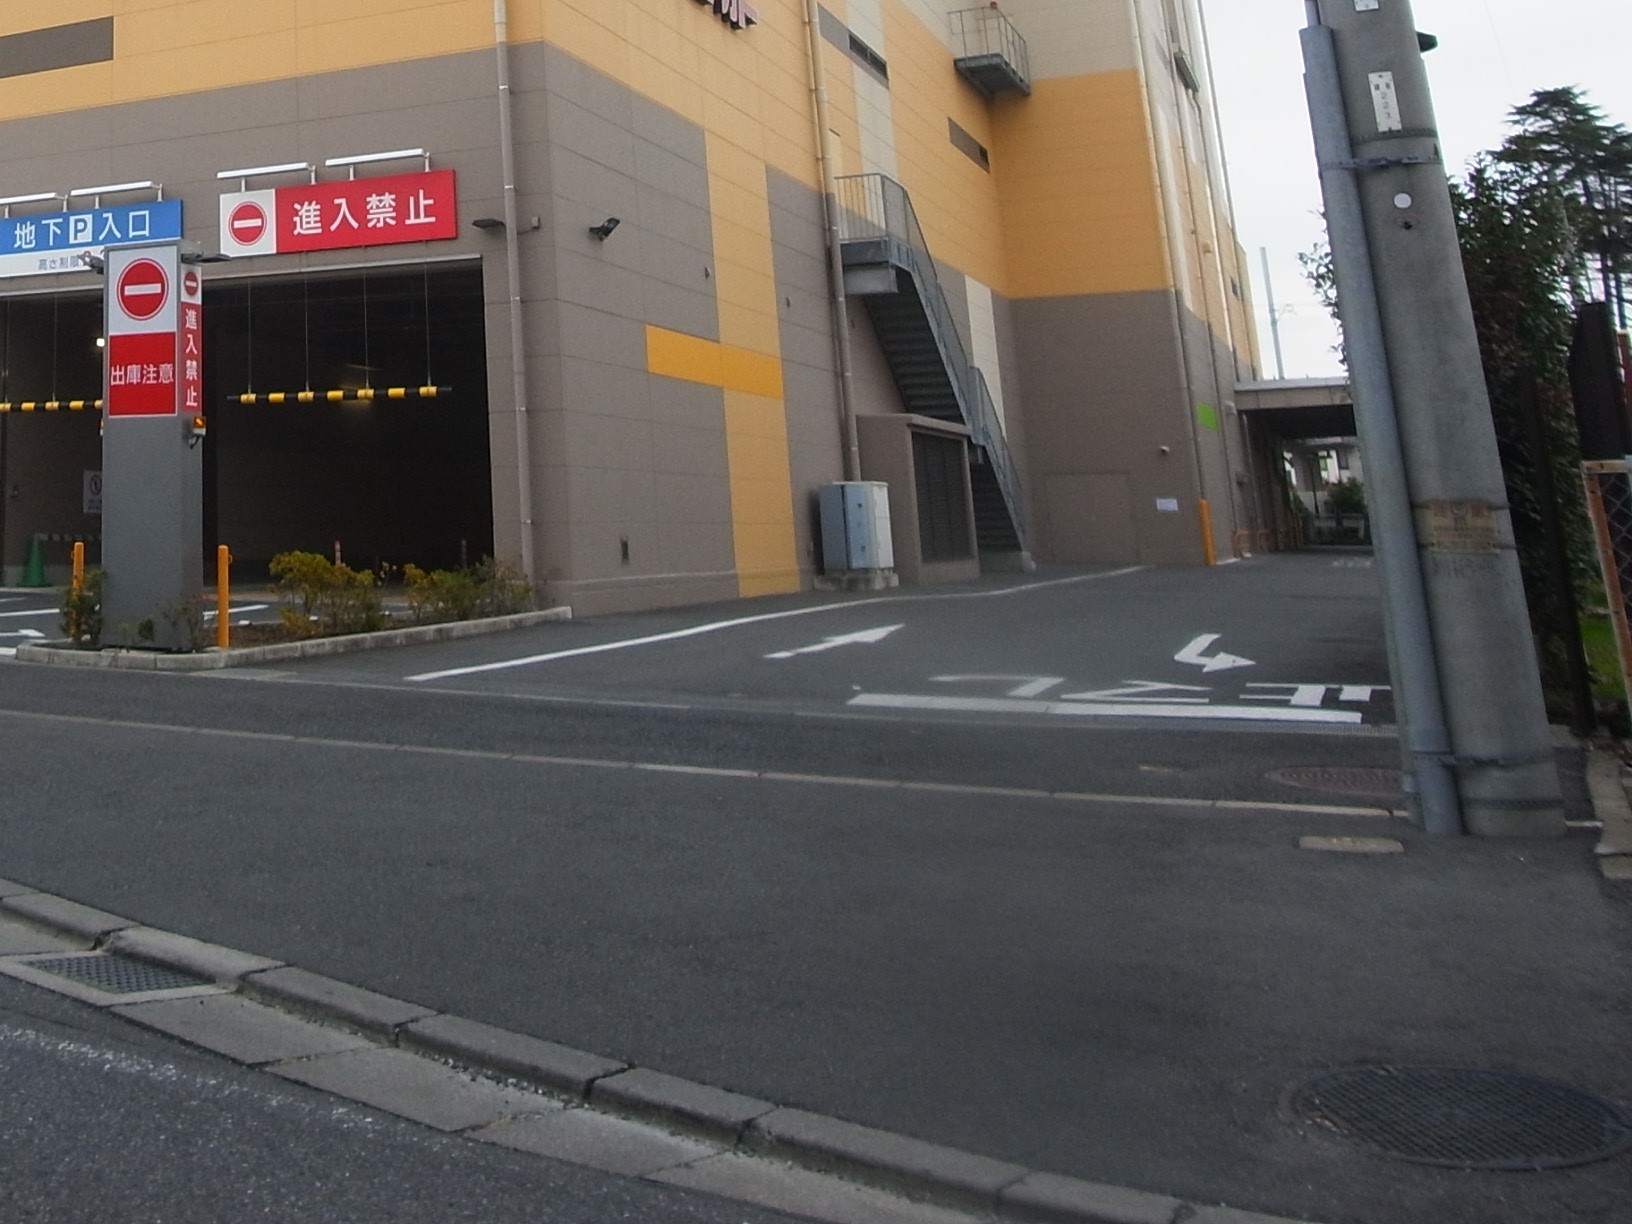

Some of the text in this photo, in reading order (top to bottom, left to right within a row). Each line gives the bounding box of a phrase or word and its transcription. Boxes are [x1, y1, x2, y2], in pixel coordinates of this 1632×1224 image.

[14, 210, 150, 249] 地下P入口
[293, 189, 436, 236] 進入禁止
[110, 363, 174, 386] 出庫注意
[185, 308, 198, 407] 進入禁止
